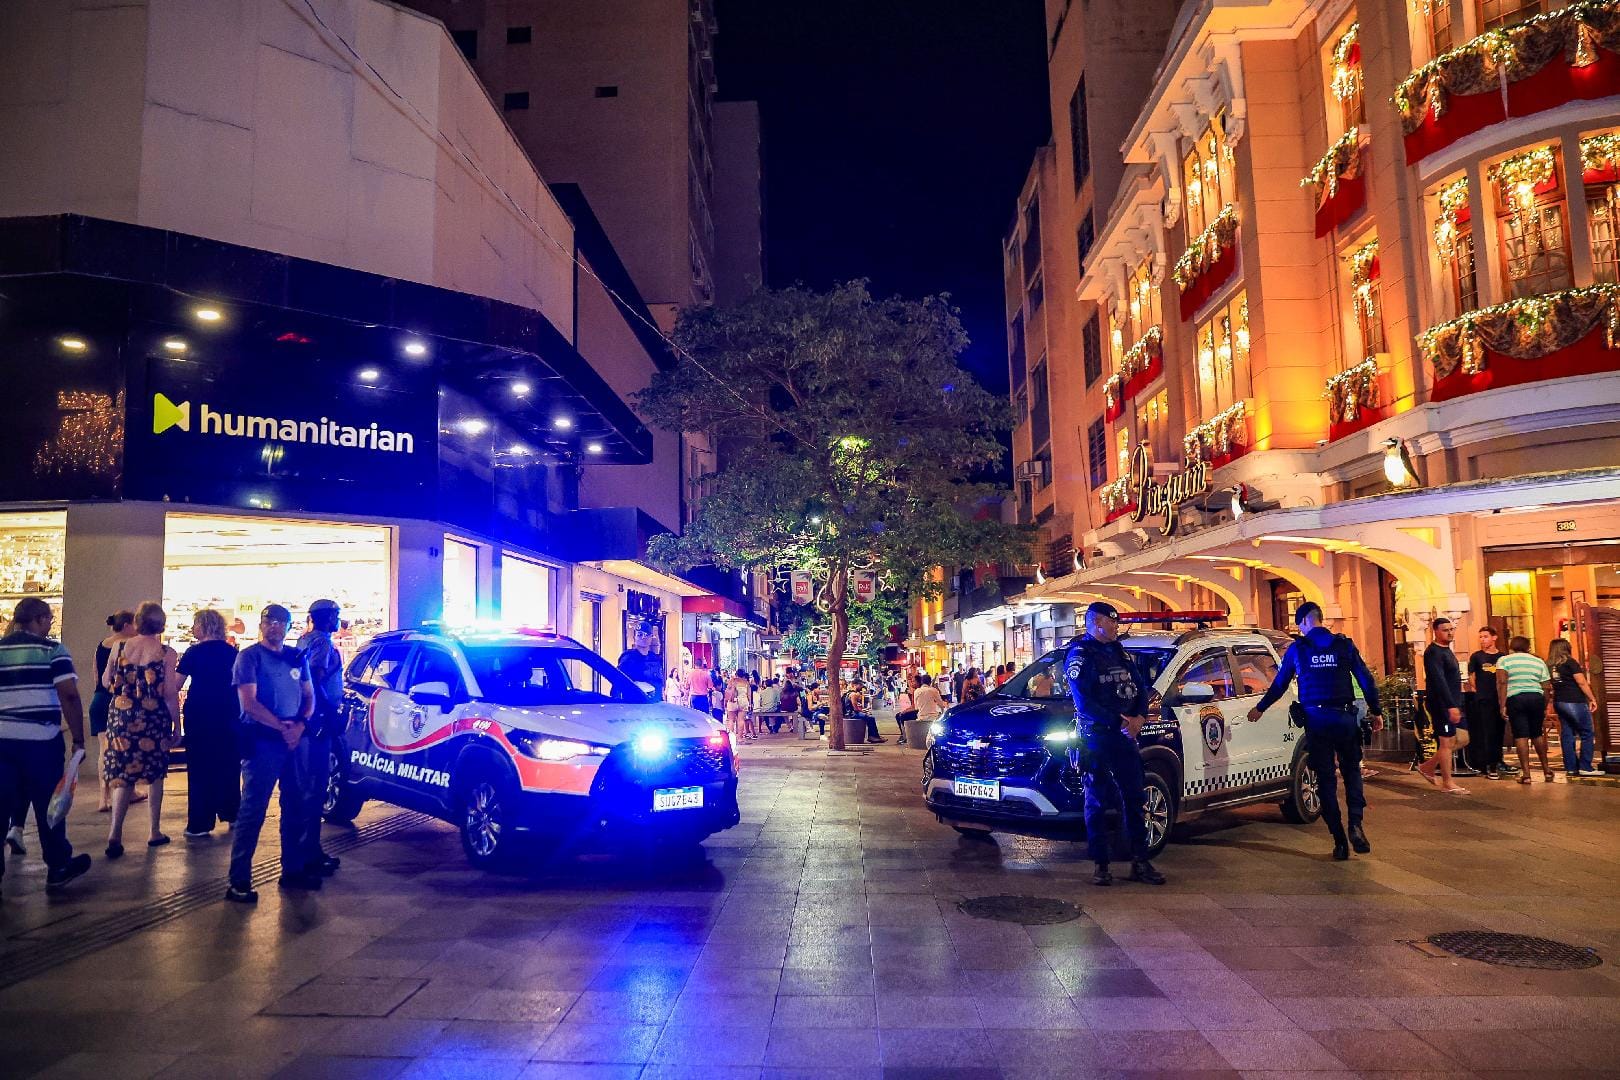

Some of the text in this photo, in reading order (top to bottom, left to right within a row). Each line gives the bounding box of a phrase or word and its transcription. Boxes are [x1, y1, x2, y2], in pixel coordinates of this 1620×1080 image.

[200, 403, 413, 453] humanitarian
[1311, 654, 1335, 664] GCM
[350, 750, 450, 788] POLÍCIA MILITAR
